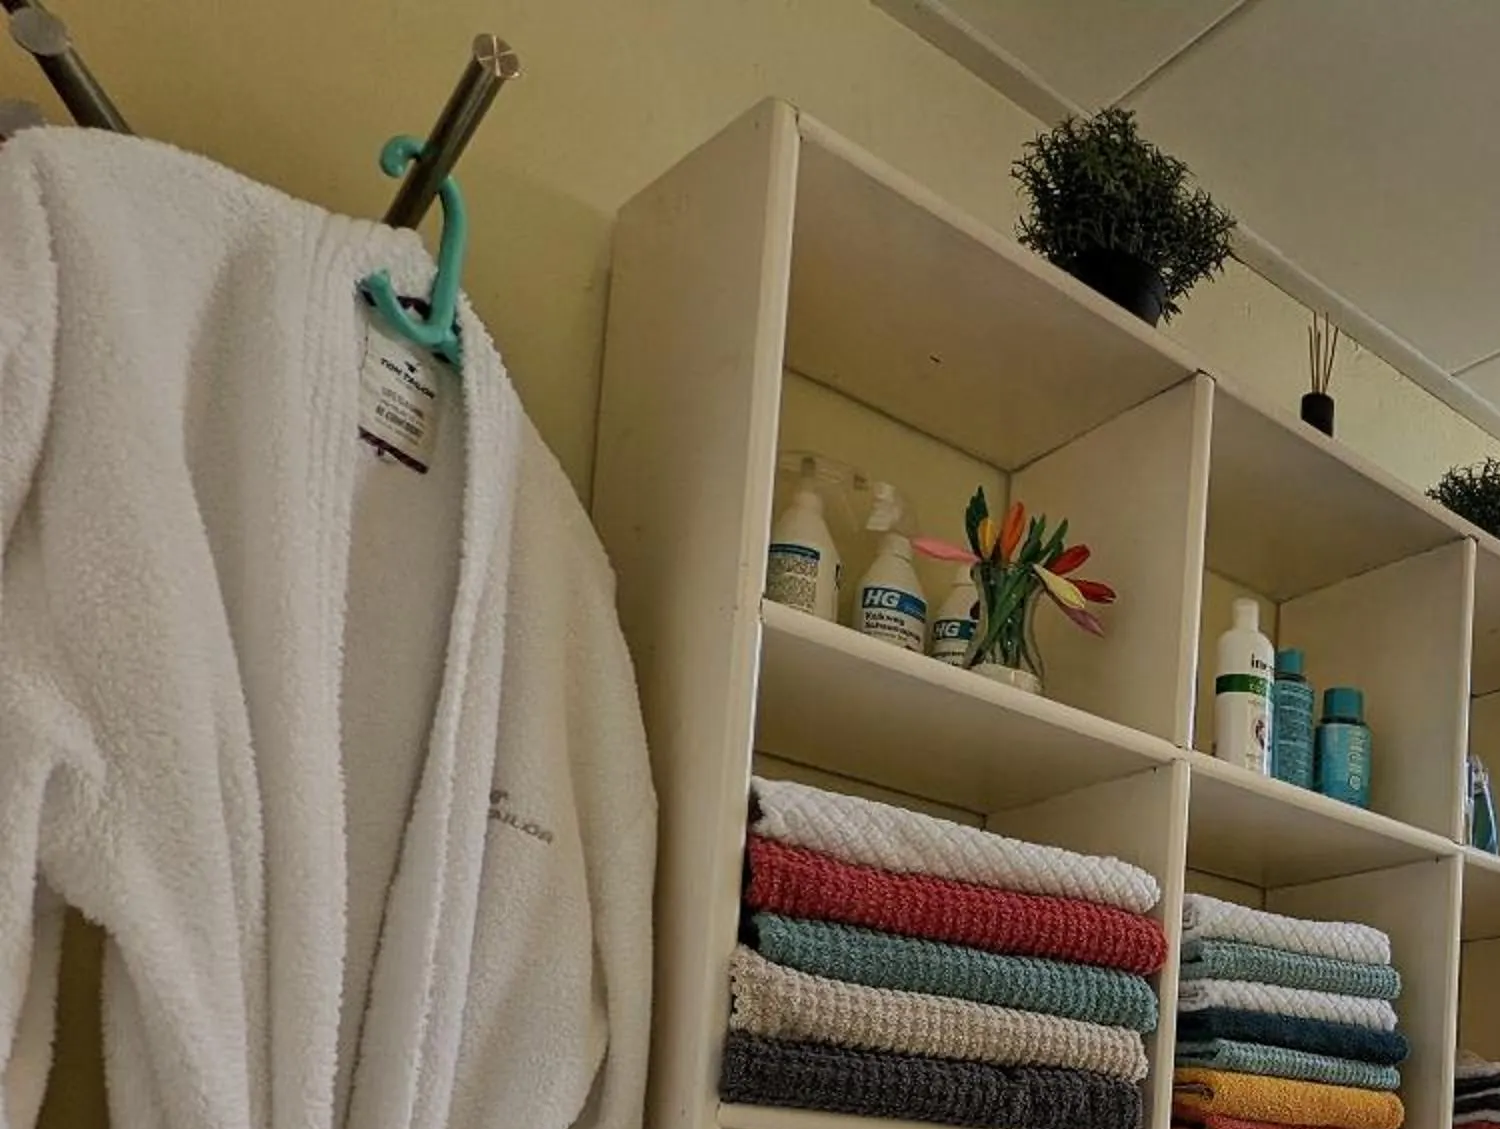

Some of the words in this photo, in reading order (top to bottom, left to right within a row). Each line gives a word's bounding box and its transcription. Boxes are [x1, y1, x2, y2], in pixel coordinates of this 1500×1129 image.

[380, 357, 402, 375] TOM
[403, 373, 436, 399] TAILOR
[864, 589, 900, 608] HG
[935, 622, 960, 636] HG
